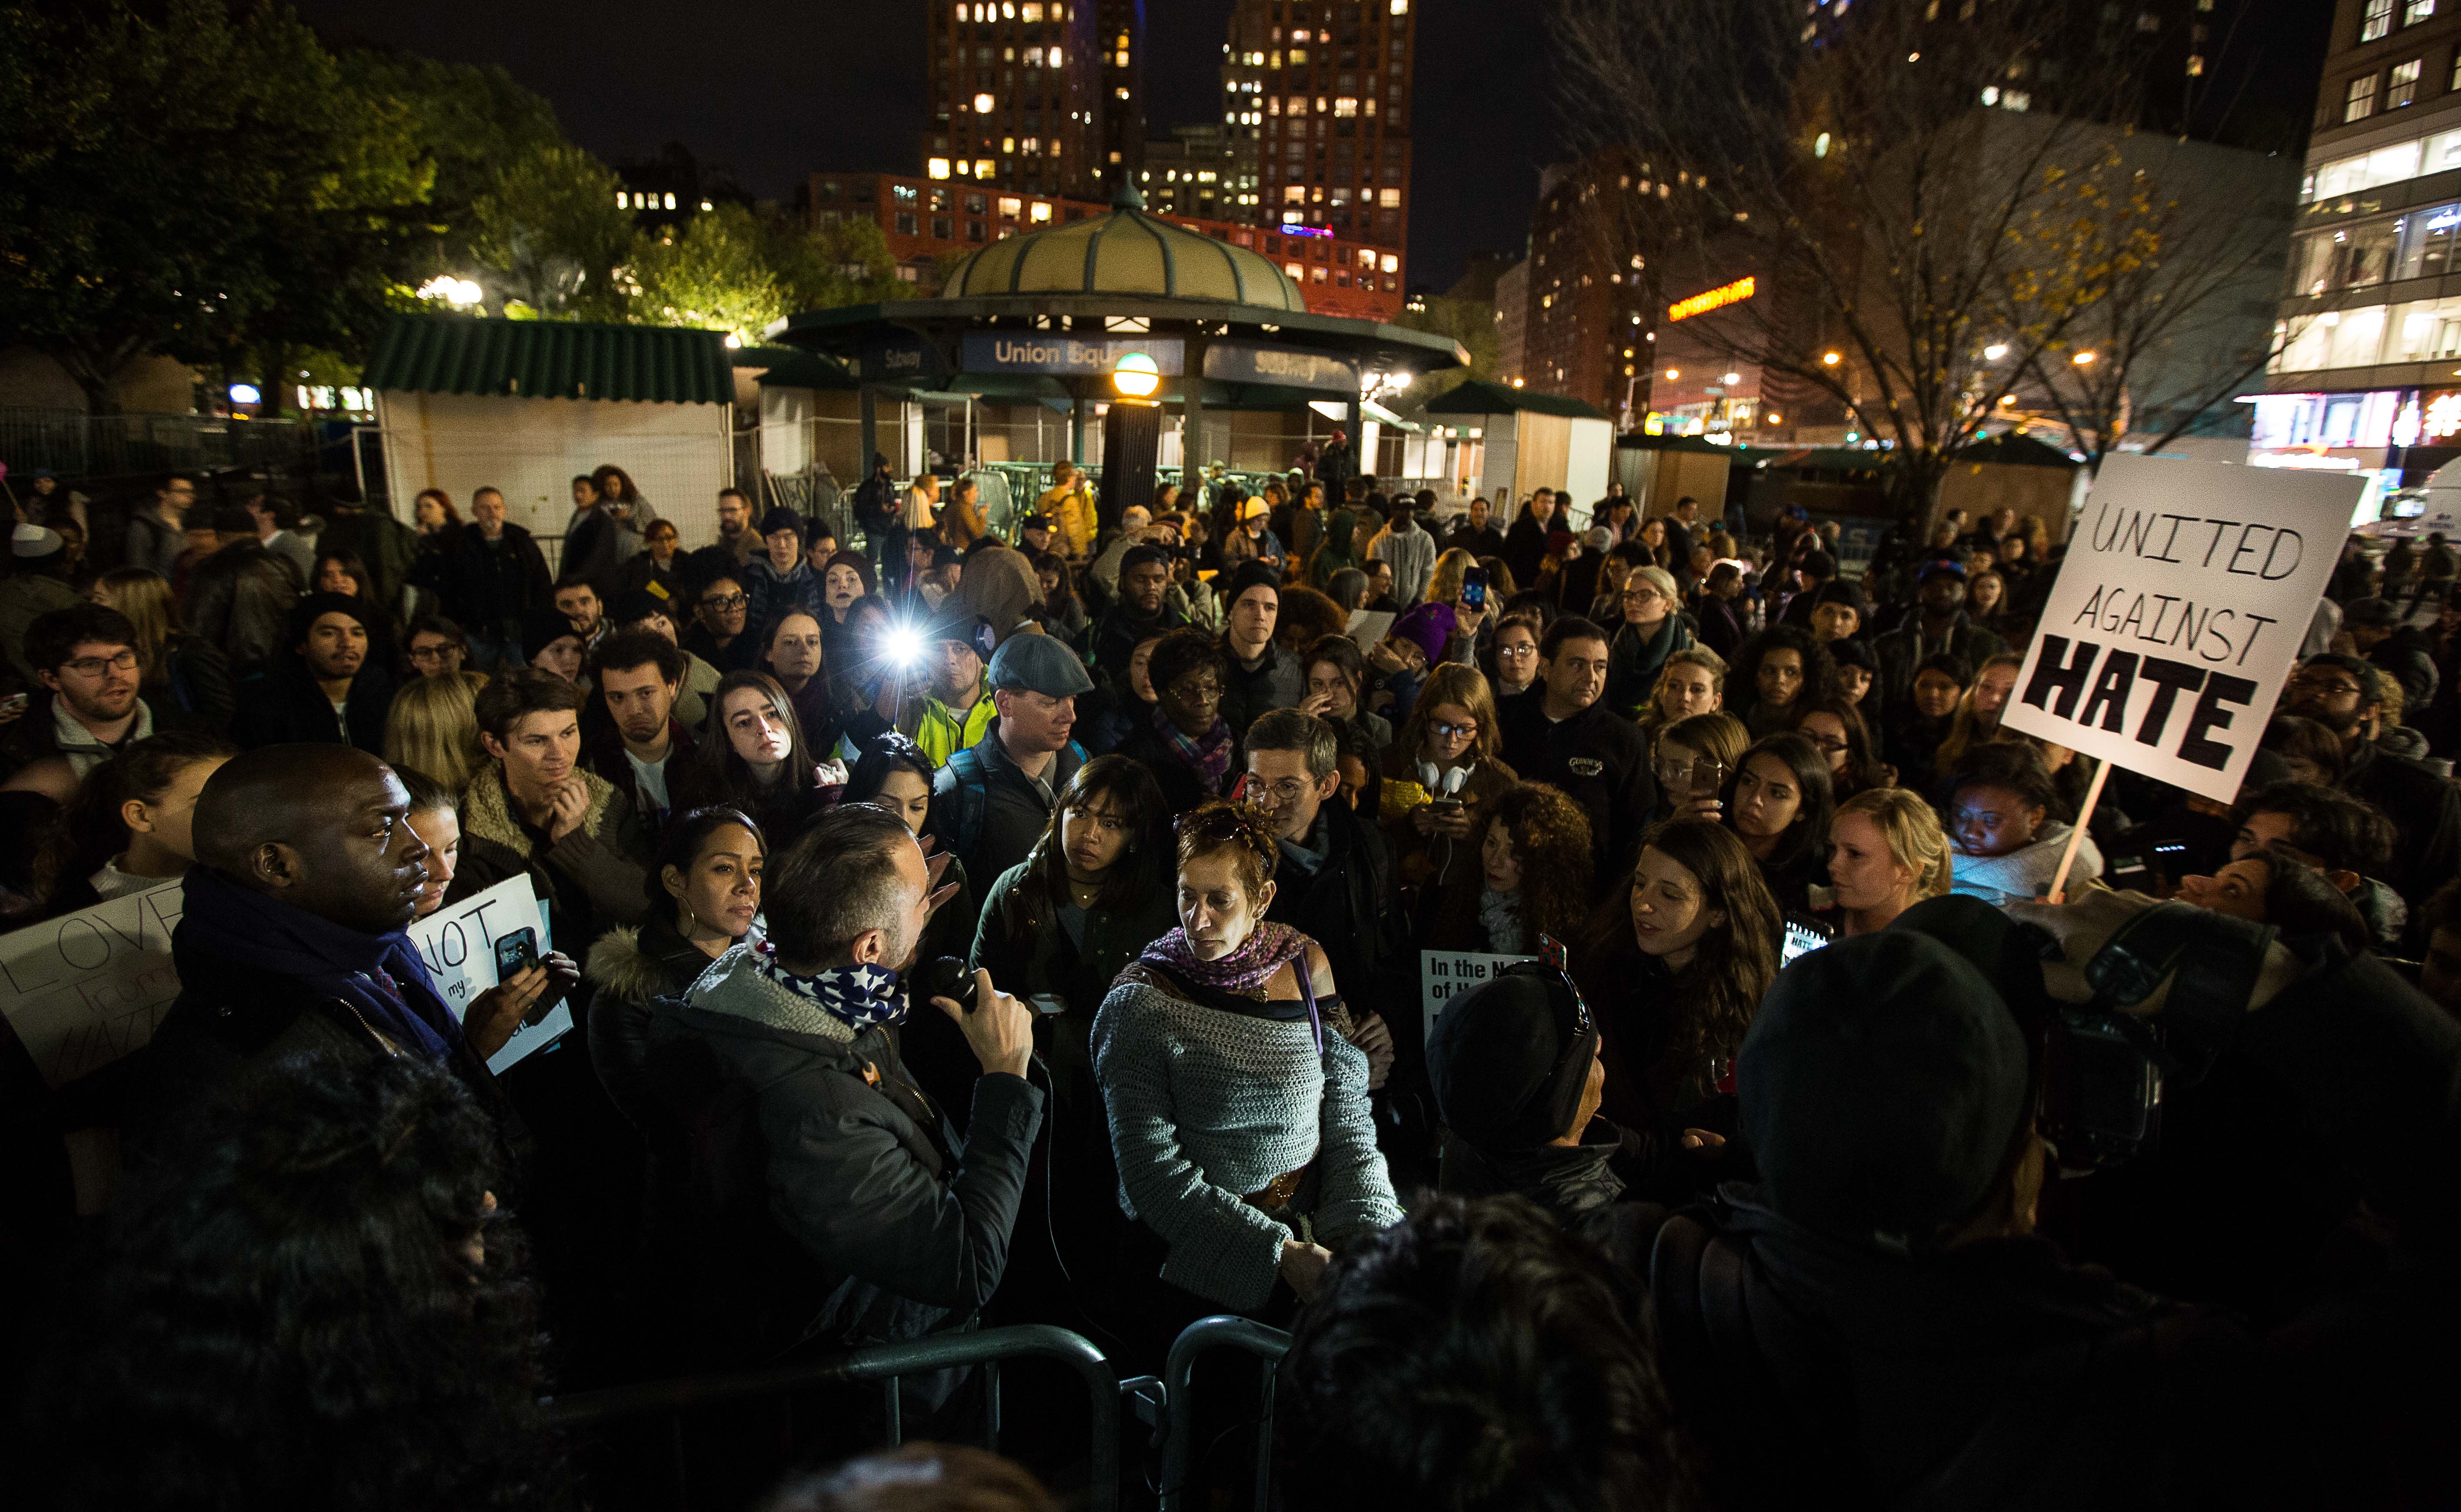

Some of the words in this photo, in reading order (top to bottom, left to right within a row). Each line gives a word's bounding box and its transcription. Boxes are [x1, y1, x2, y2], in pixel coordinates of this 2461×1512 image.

[885, 348, 922, 369] Subway
[995, 340, 1059, 363] Union
[2092, 503, 2304, 581] UNITED
[2074, 584, 2277, 666] AGAINST
[2022, 633, 2258, 772] HATE
[1431, 957, 1448, 976] In
[1455, 959, 1486, 978] the
[448, 980, 465, 999] my
[1432, 982, 1451, 998] of
